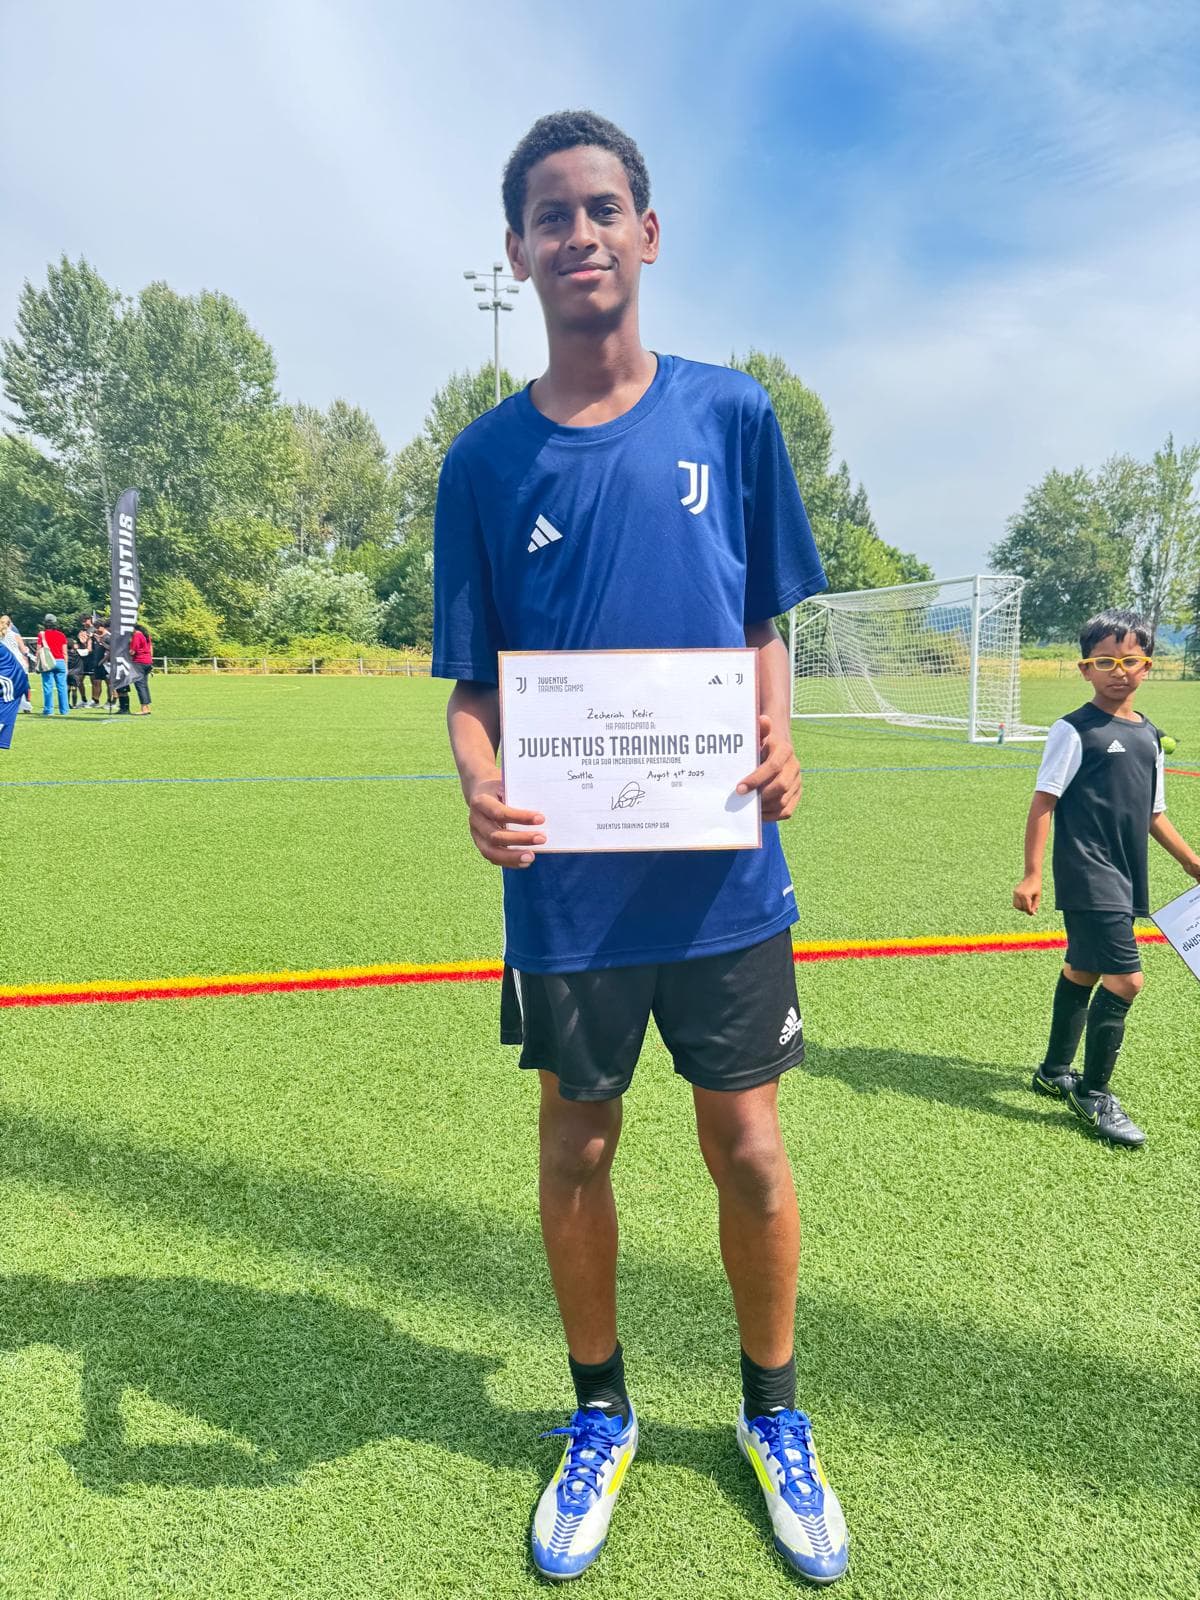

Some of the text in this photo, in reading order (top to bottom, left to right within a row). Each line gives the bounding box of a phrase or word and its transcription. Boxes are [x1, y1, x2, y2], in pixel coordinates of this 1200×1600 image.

[118, 512, 139, 636] JUVENTUS
[537, 676, 568, 685] JUVENTUS
[564, 684, 584, 693] CAMPS
[518, 733, 743, 758] JUVENTUS TRAINING CAMP
[581, 758, 592, 766] PER
[596, 823, 621, 831] JUVENTUS
